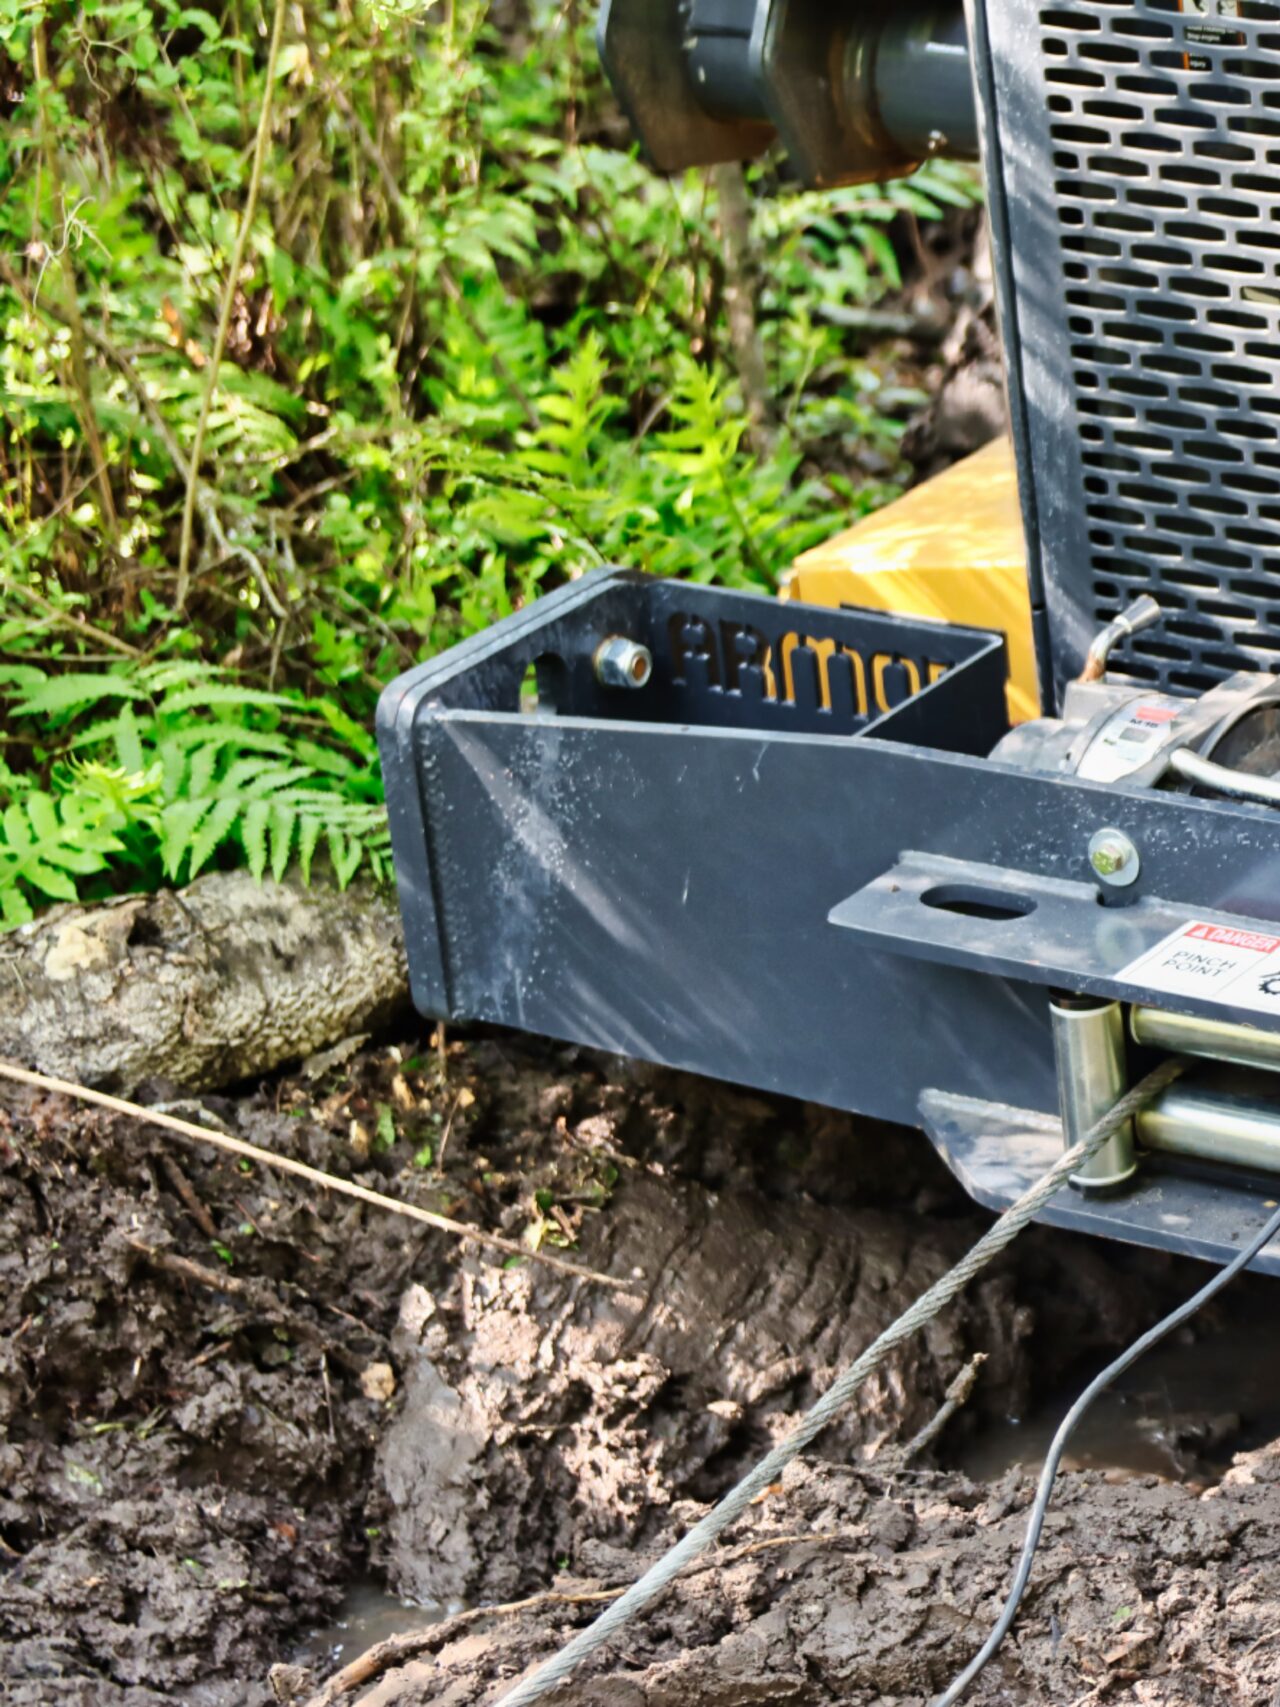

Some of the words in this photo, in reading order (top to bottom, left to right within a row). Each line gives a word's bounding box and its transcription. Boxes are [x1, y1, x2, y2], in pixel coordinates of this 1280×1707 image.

[1209, 928, 1276, 952] DANGER
[1161, 959, 1225, 977] POINT
[1173, 951, 1237, 969] PINCH
